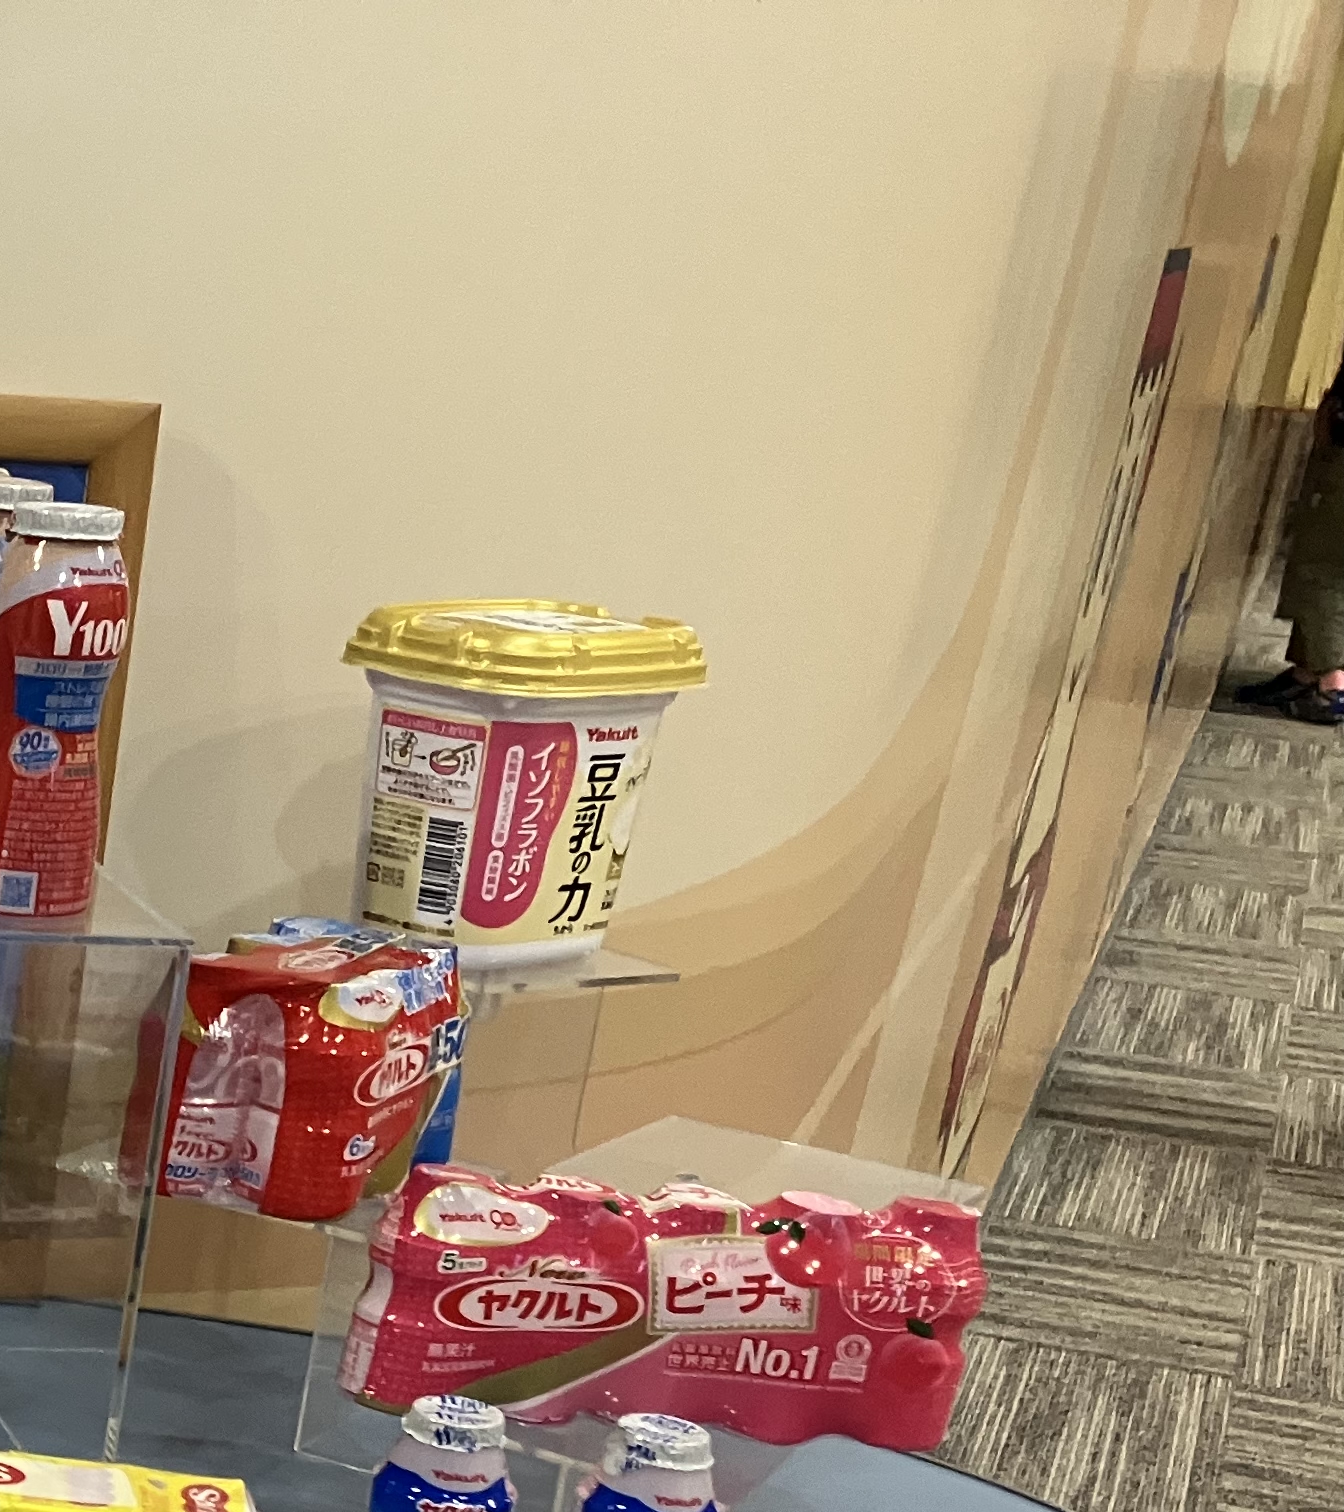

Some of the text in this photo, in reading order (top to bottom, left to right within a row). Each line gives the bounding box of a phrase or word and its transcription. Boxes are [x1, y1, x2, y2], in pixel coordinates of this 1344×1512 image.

[503, 741, 558, 903] イソフラボン
[547, 752, 627, 925] 豆乳の力
[478, 1290, 602, 1323] ヤクルト
[665, 1271, 786, 1315] ピーチ
[851, 1288, 936, 1318] ヤクルト
[734, 1337, 820, 1380] No.1
